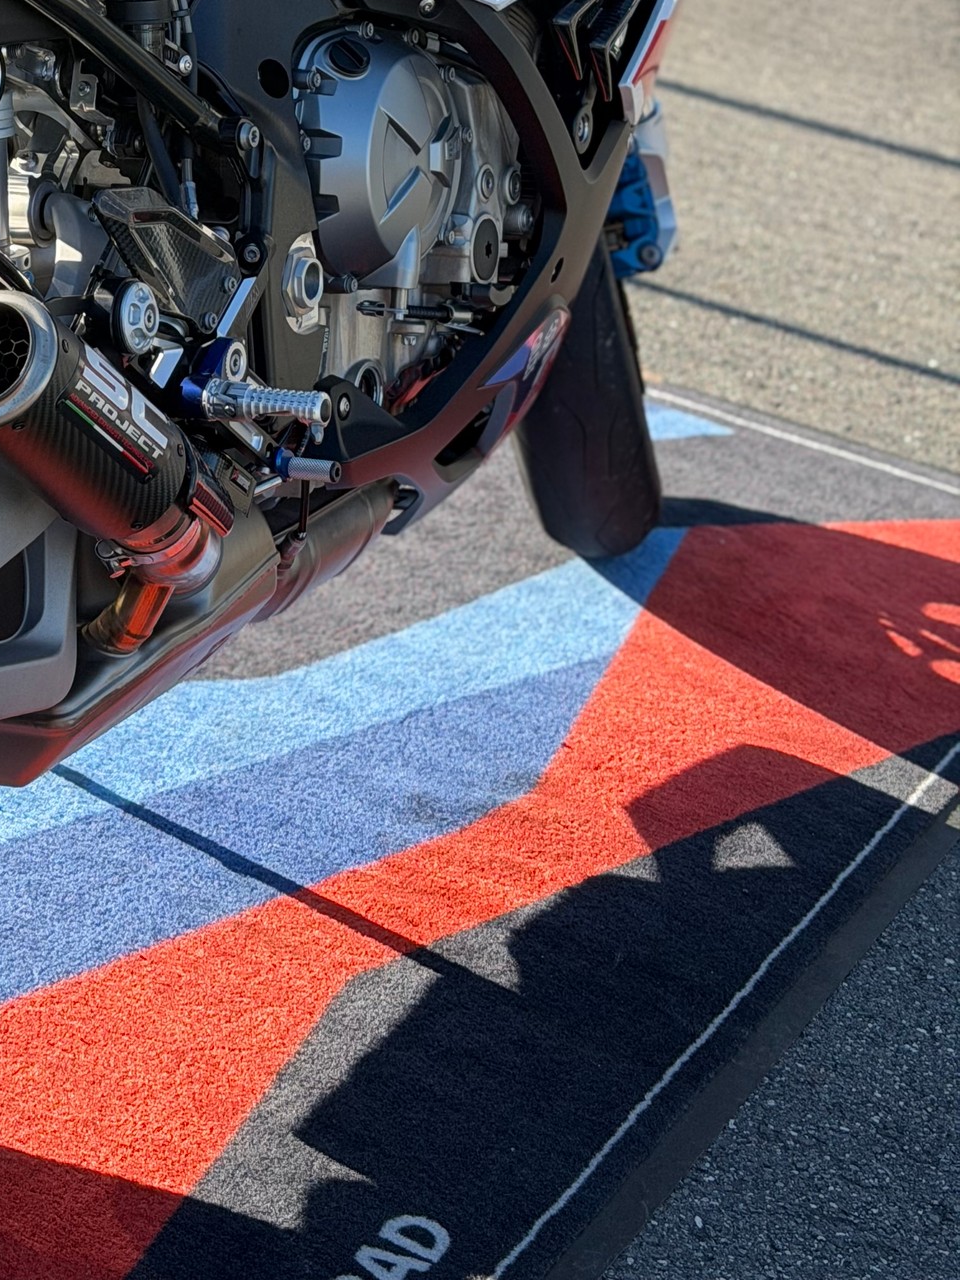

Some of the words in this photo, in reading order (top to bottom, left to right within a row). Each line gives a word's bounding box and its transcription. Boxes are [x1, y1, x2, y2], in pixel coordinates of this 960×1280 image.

[75, 379, 163, 459] PROJECT
[82, 343, 170, 450] SC
[334, 1214, 451, 1280] AD
